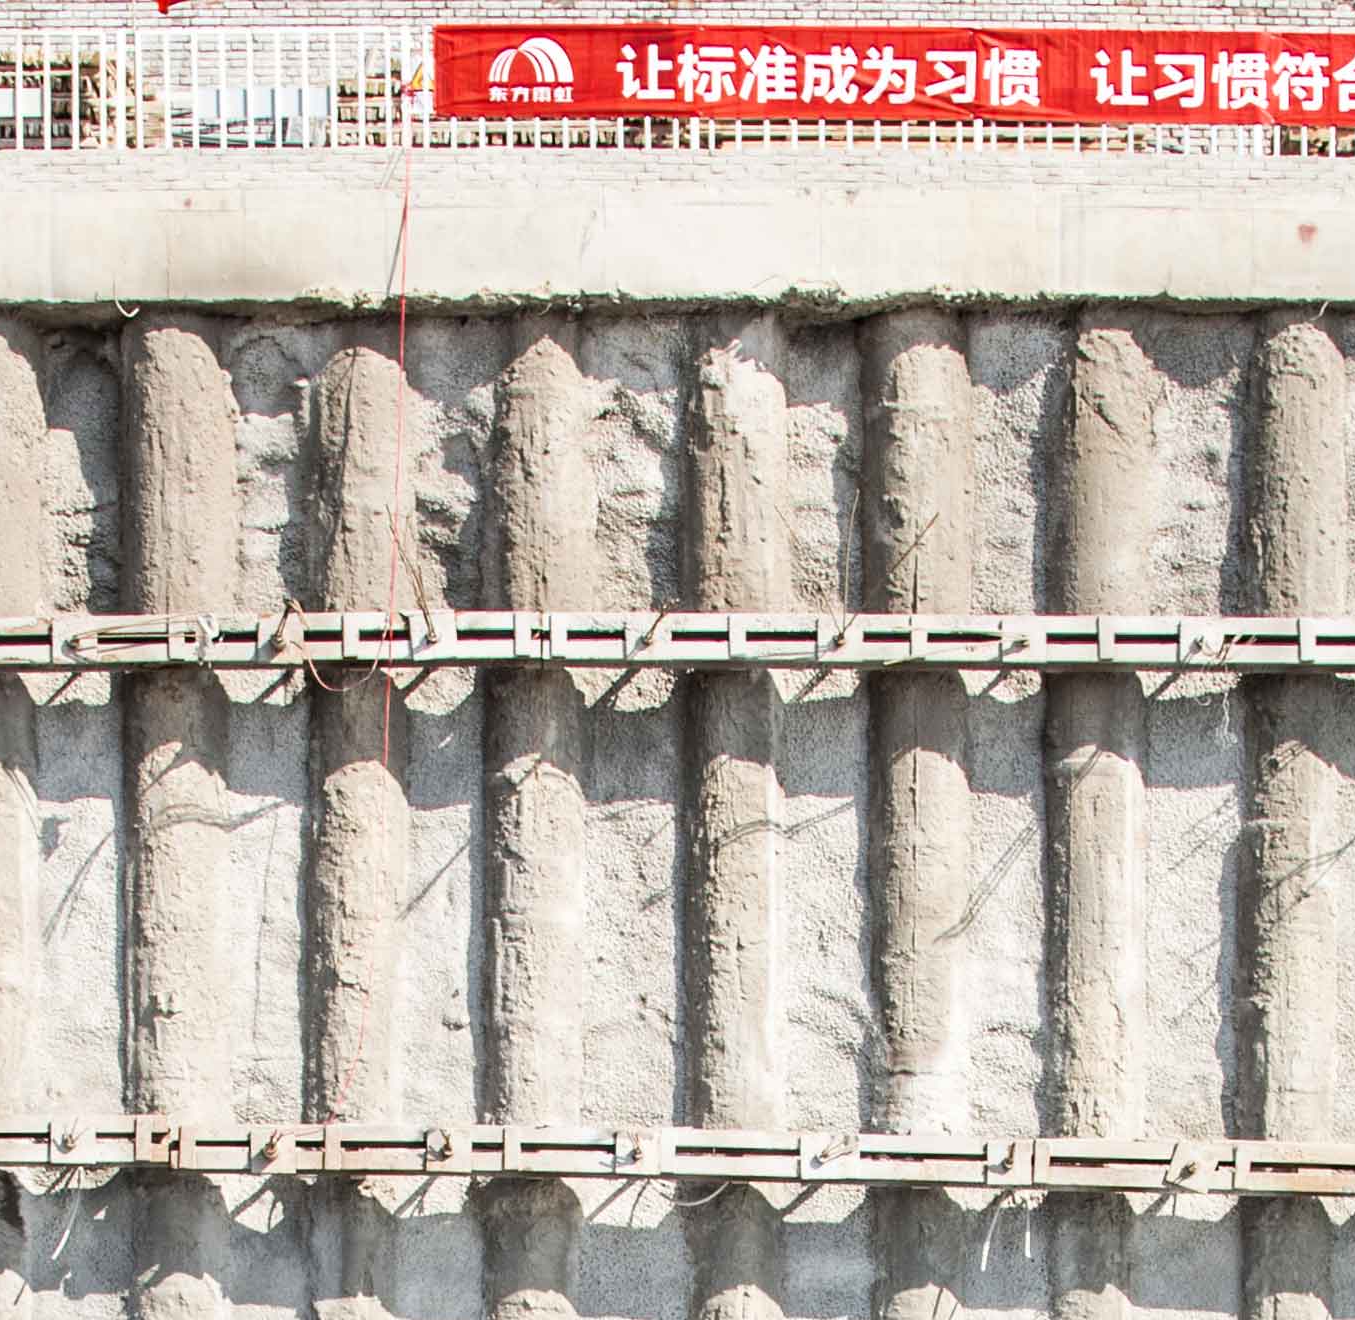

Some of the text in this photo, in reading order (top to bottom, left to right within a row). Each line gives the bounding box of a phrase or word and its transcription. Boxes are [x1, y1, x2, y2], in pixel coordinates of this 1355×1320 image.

[488, 86, 574, 103] 东方雨虹
[615, 43, 1042, 107] 让标准成为习惯
